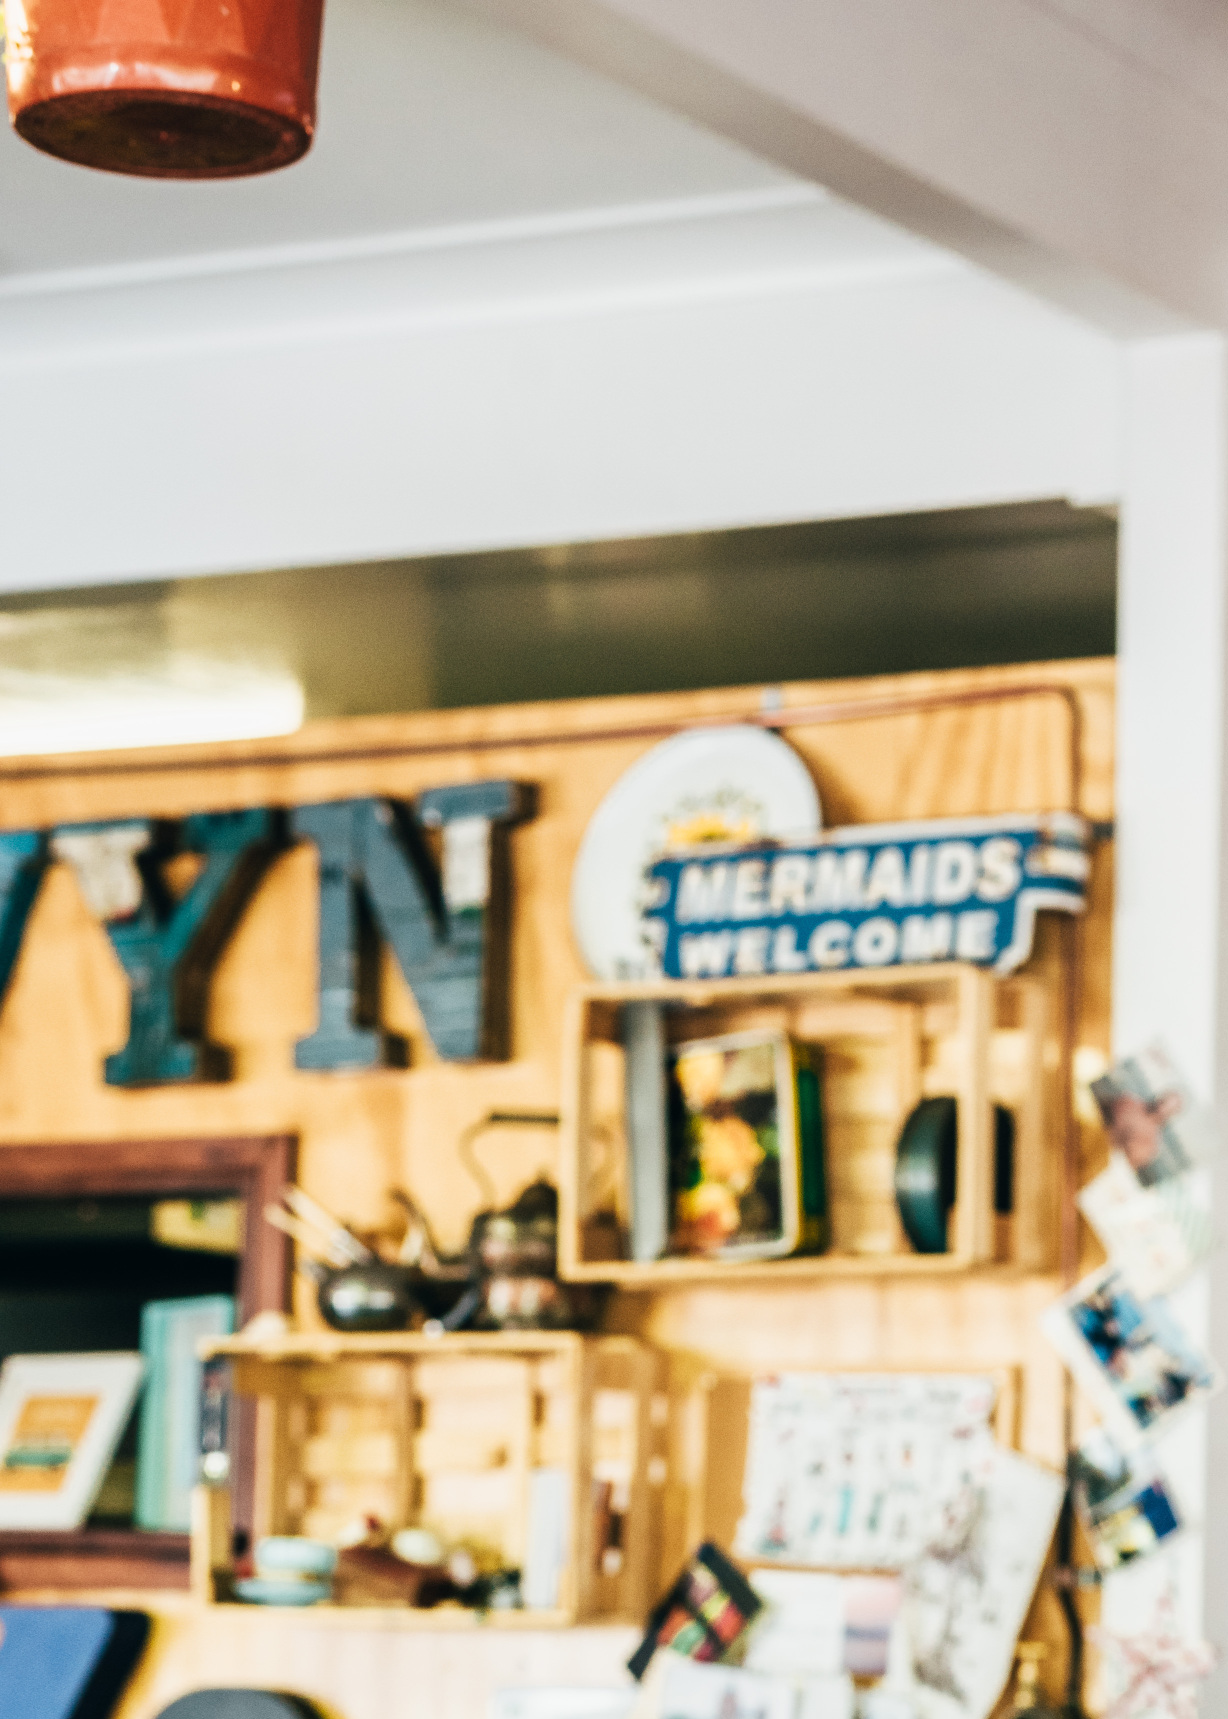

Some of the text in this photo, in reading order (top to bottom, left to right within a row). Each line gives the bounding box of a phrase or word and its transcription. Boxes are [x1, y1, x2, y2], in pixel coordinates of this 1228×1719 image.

[676, 836, 1022, 924] MERMAIDS
[0, 779, 538, 1087] YN
[679, 909, 999, 976] WELCOME
